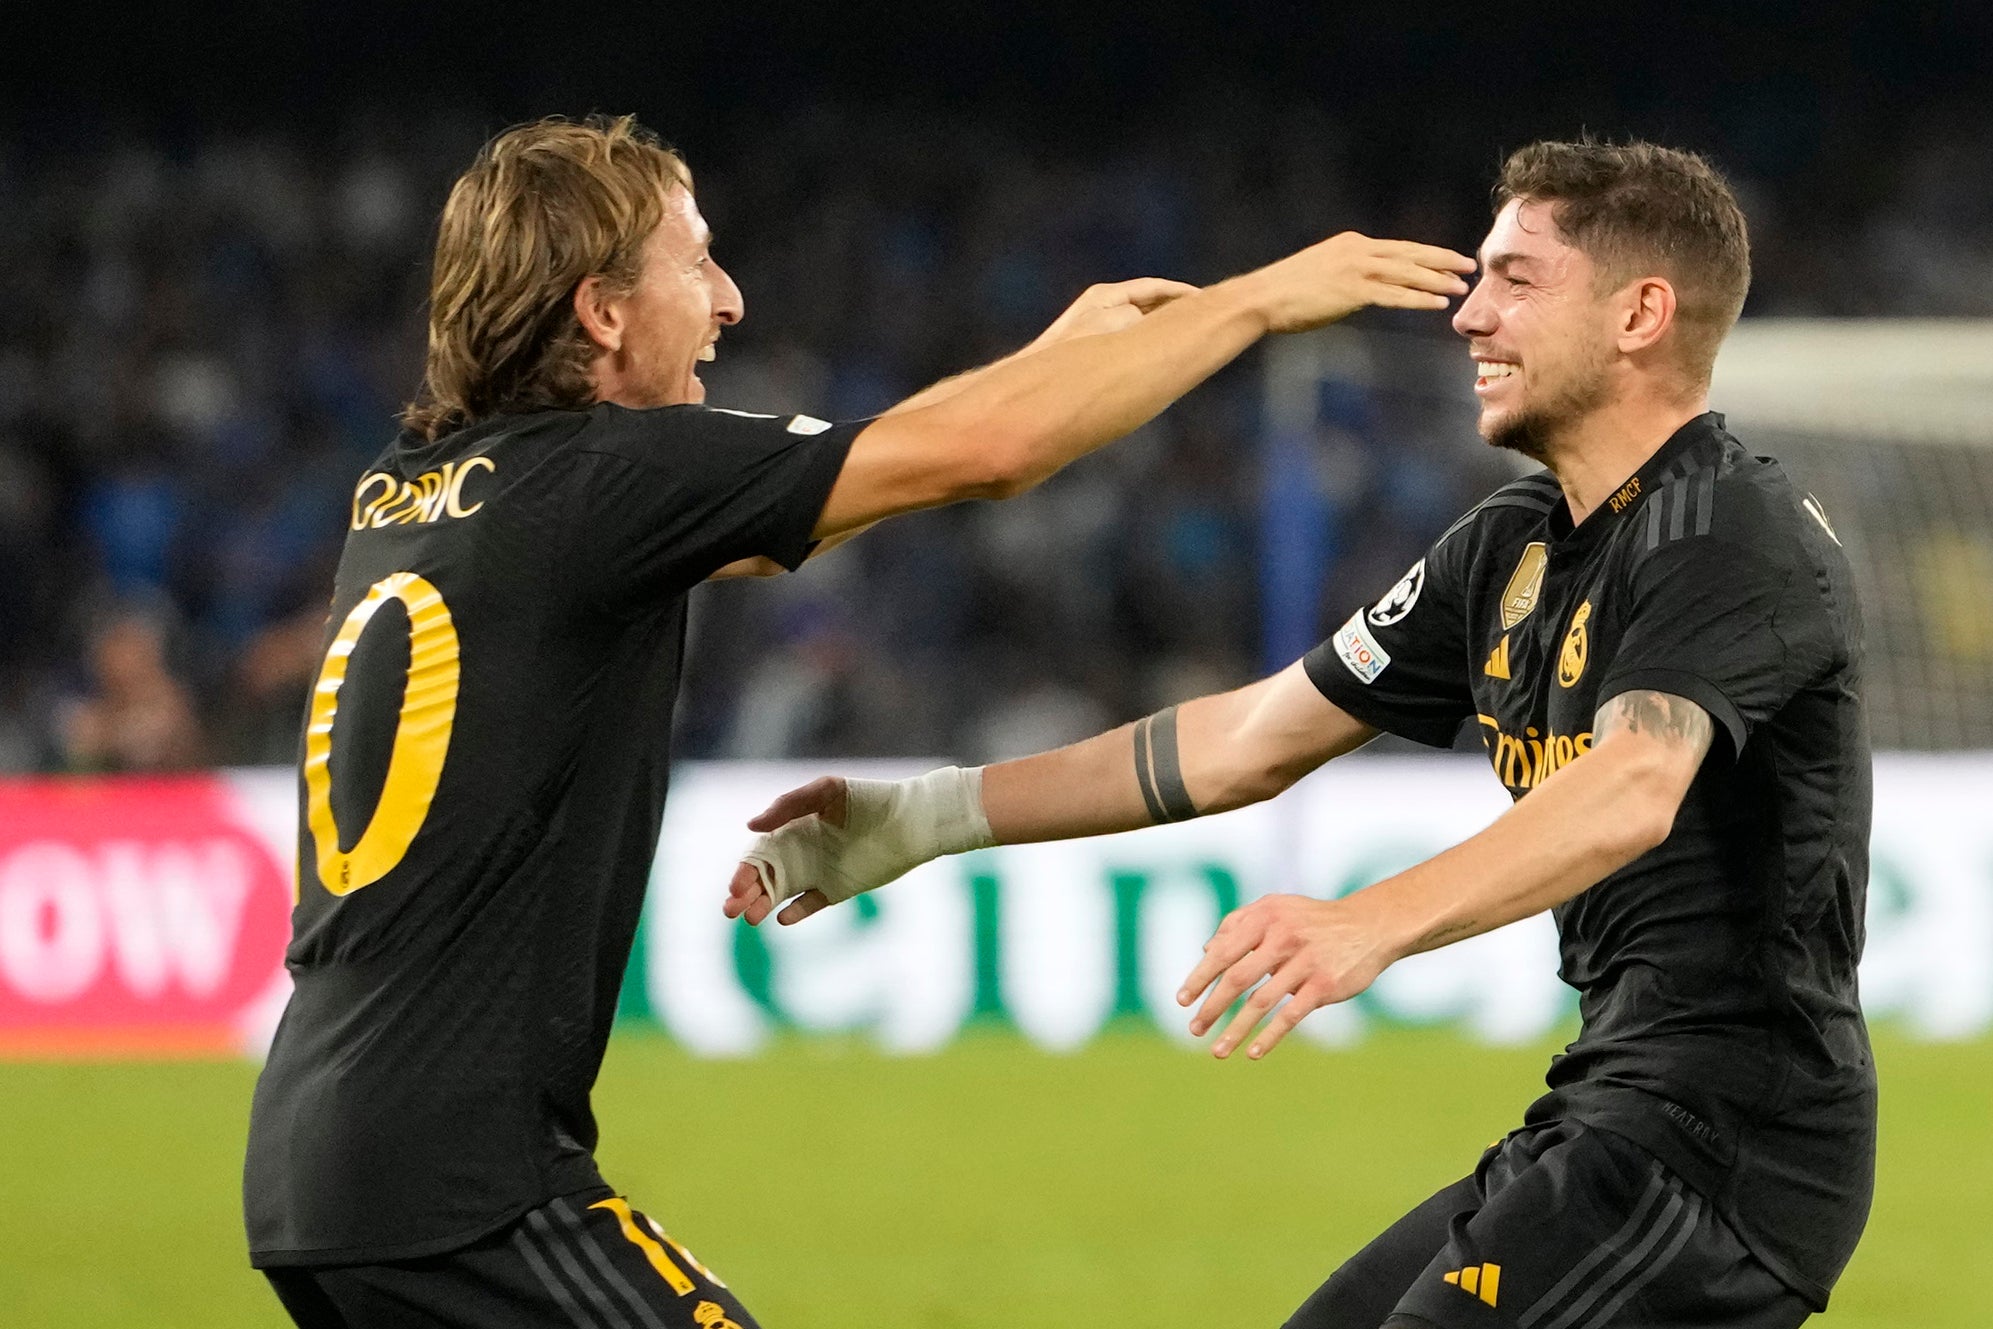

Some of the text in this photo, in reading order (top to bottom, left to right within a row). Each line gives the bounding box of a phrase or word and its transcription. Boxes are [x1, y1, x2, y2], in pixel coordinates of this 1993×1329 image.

[351, 456, 496, 531] ODRIC
[1608, 476, 1642, 514] RMCF
[1343, 630, 1383, 675] ATION
[294, 571, 461, 897] 0
